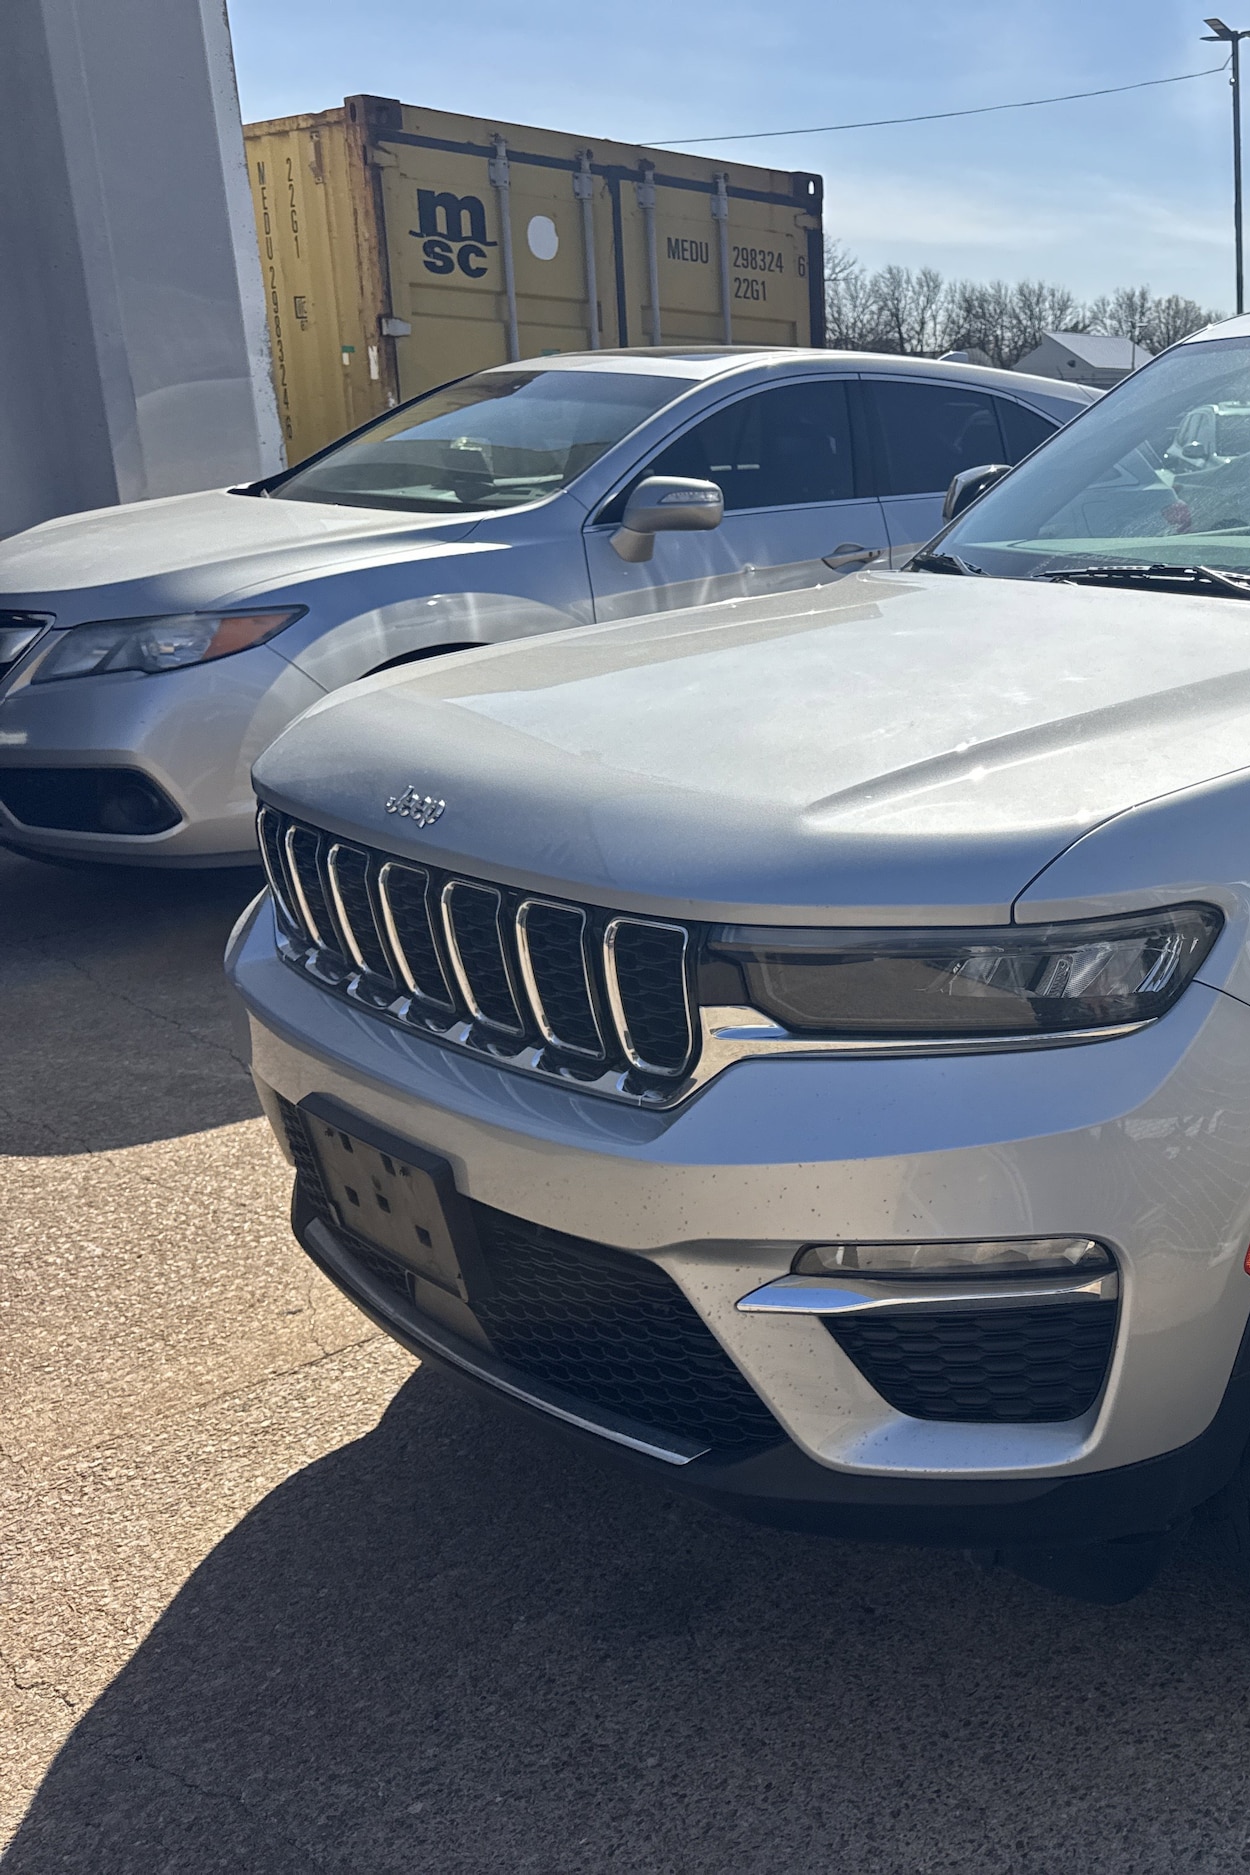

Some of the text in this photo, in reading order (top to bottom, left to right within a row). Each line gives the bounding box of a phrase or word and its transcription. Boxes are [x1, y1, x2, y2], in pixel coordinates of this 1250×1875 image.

[667, 237, 806, 277] MEDU 298324 6
[734, 277, 766, 301] 22G1
[385, 784, 446, 829] Jeep
